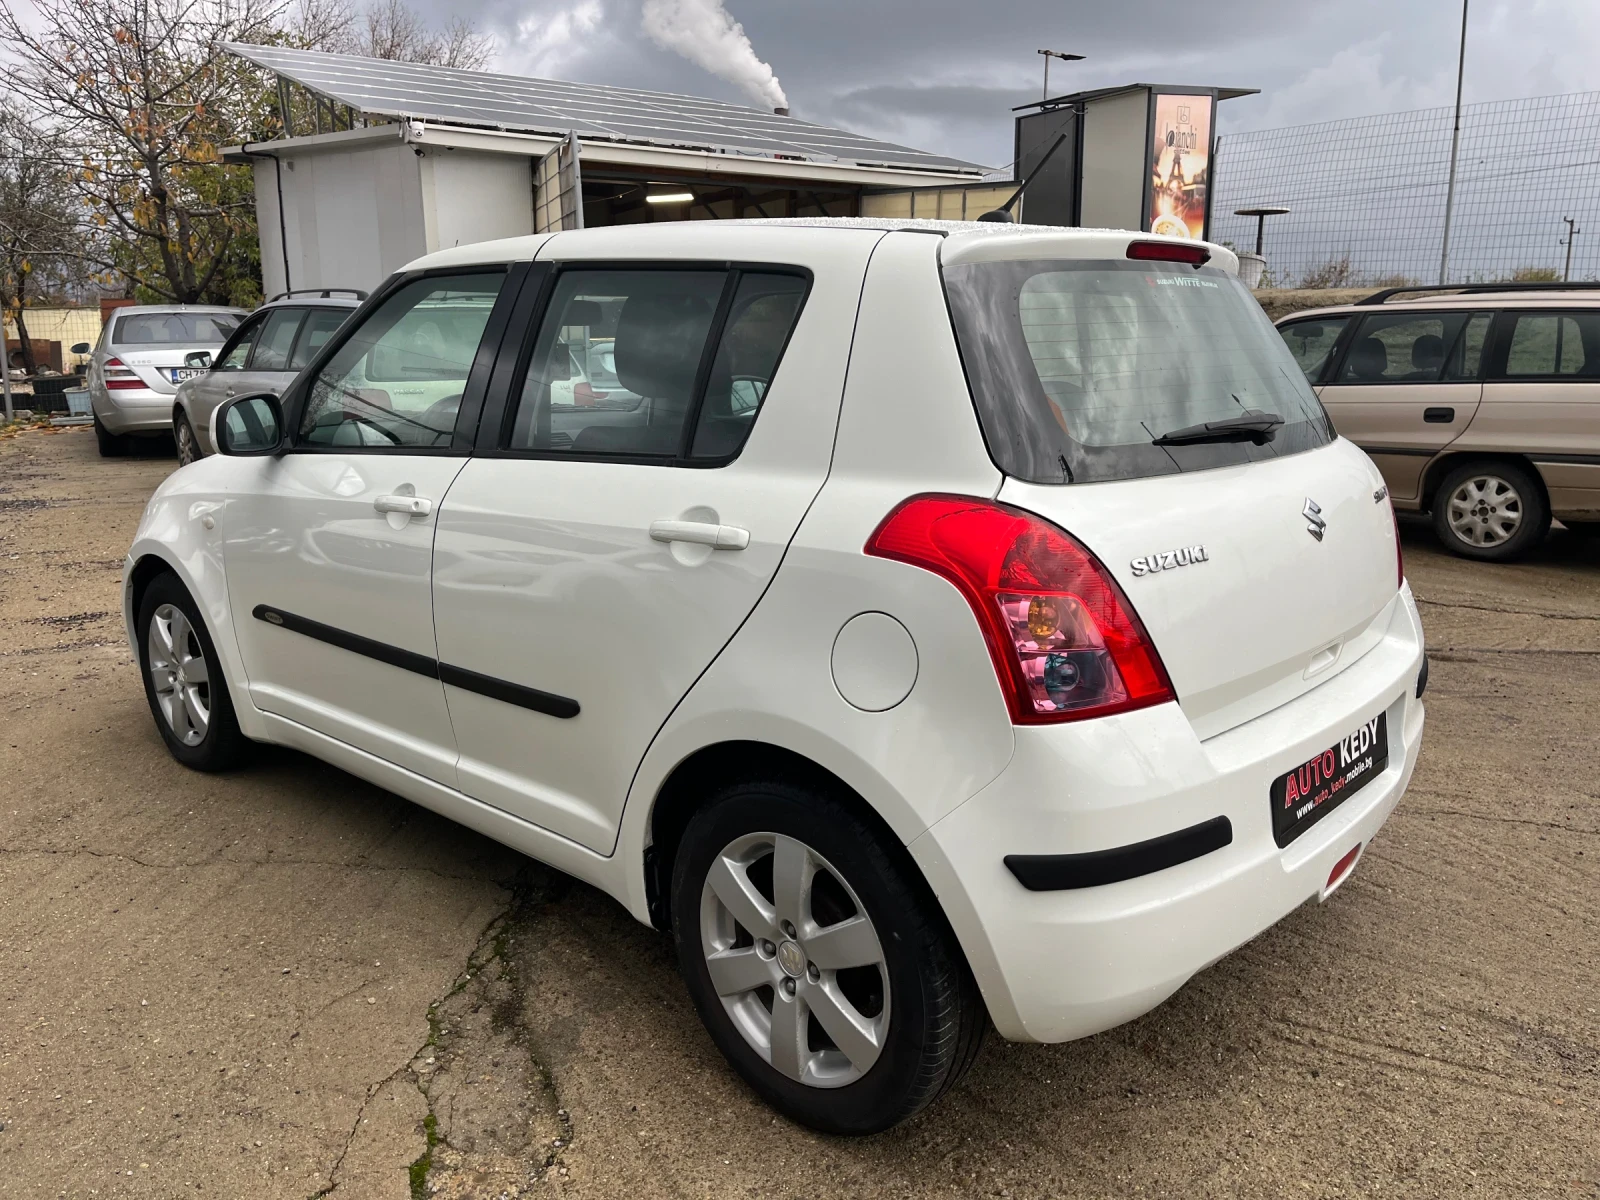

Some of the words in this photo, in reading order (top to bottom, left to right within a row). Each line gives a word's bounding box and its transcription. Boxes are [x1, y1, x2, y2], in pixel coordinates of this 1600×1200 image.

[1174, 276, 1201, 287] WITTE
[179, 370, 193, 380] CH
[1130, 544, 1209, 577] SUZUKI
[1285, 748, 1335, 809] AUTO
[1340, 716, 1379, 768] KEDY
[1296, 756, 1373, 820] www.auto_kedy.mobile.bg
